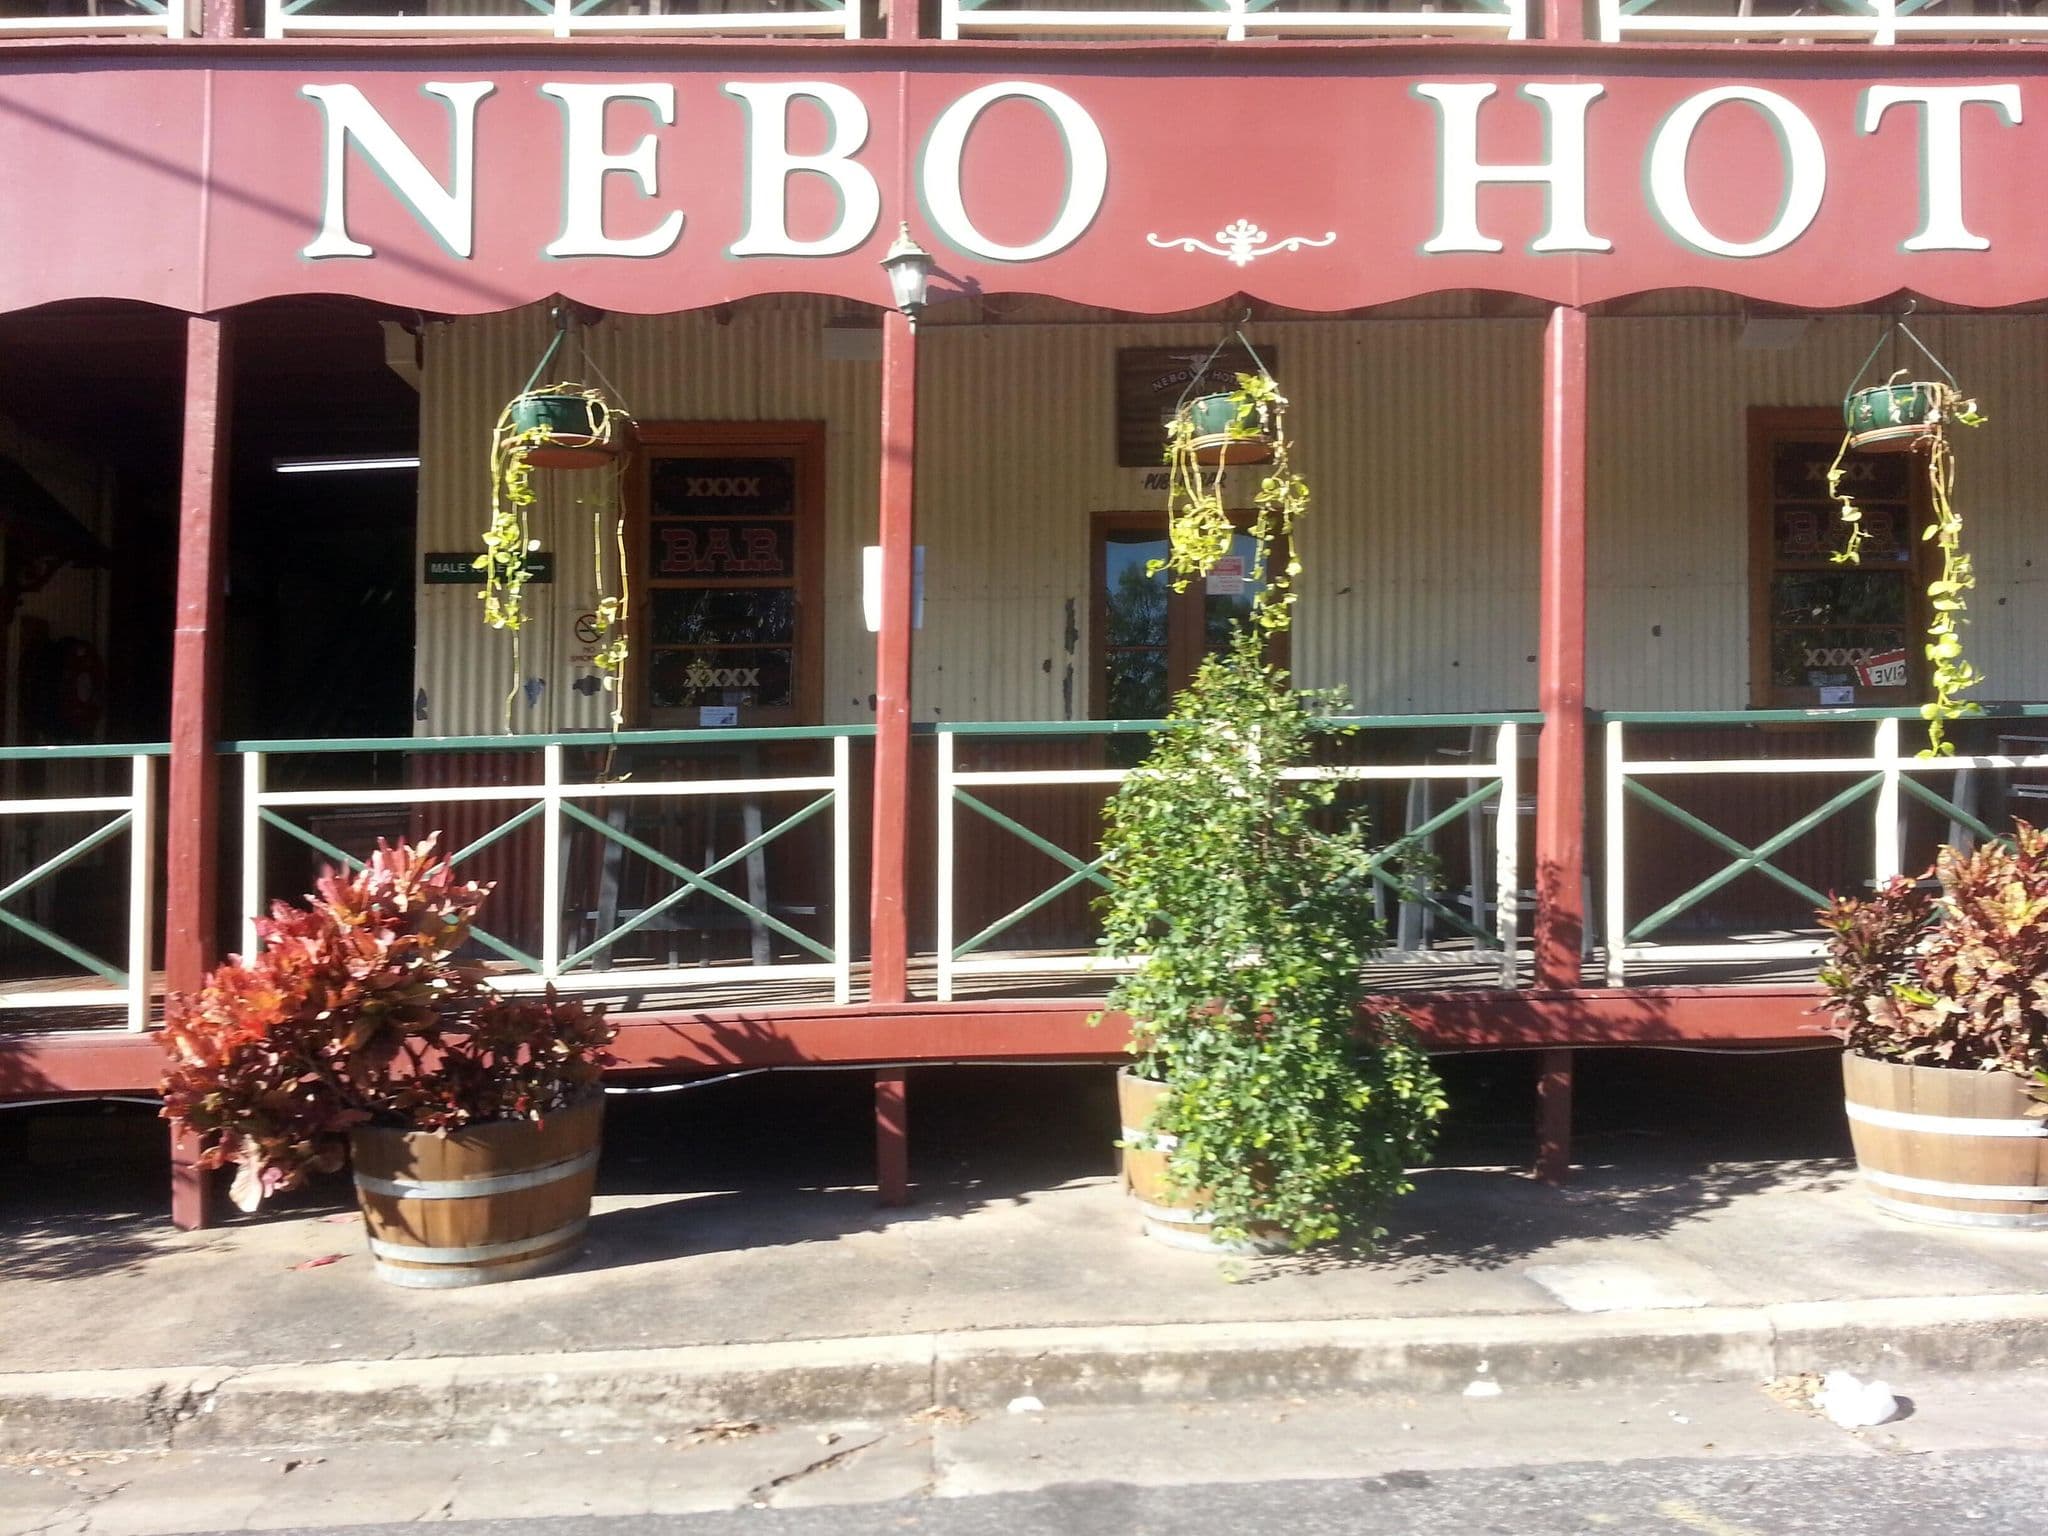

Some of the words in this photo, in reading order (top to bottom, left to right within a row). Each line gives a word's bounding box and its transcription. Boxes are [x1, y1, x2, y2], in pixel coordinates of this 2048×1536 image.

[301, 80, 1108, 260] NEBO
[1414, 82, 2023, 257] HOT
[1152, 371, 1188, 391] NEBO
[1804, 462, 1877, 481] XXX
[686, 477, 759, 496] XXXX
[661, 528, 783, 572] BAR
[431, 563, 466, 573] MALE
[1802, 647, 1873, 666] XXXX
[685, 667, 759, 687] XXXX
